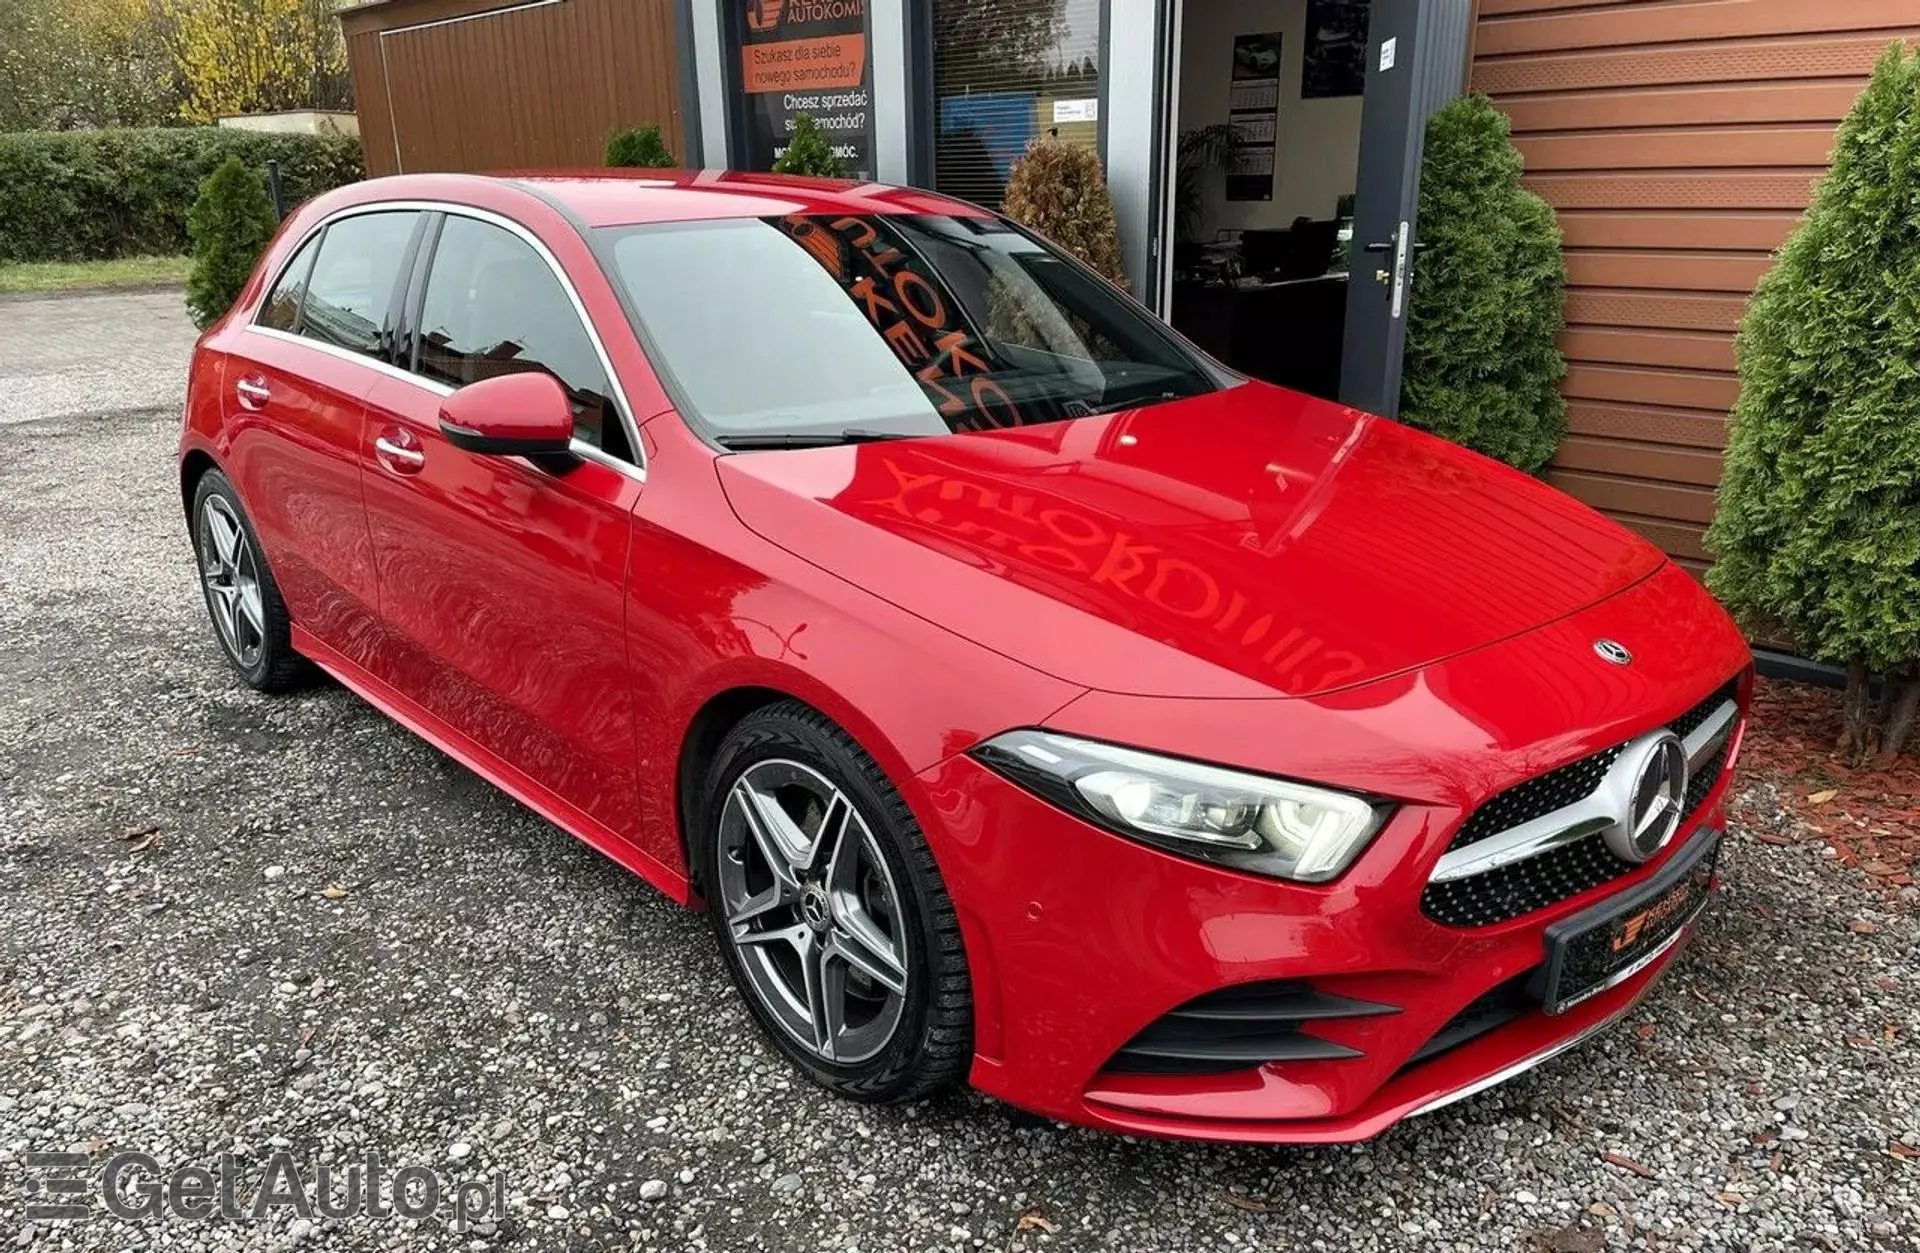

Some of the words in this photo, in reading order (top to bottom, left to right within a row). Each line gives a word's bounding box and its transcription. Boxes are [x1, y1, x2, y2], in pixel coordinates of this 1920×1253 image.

[753, 48, 792, 64] Szukasz
[795, 45, 810, 61] dla
[812, 43, 841, 60] siebie
[755, 69, 792, 87] nowego
[793, 61, 856, 82] samochodu?
[783, 94, 820, 110] Chcesz
[820, 90, 868, 111] sprzedać
[811, 111, 866, 130] amochód?
